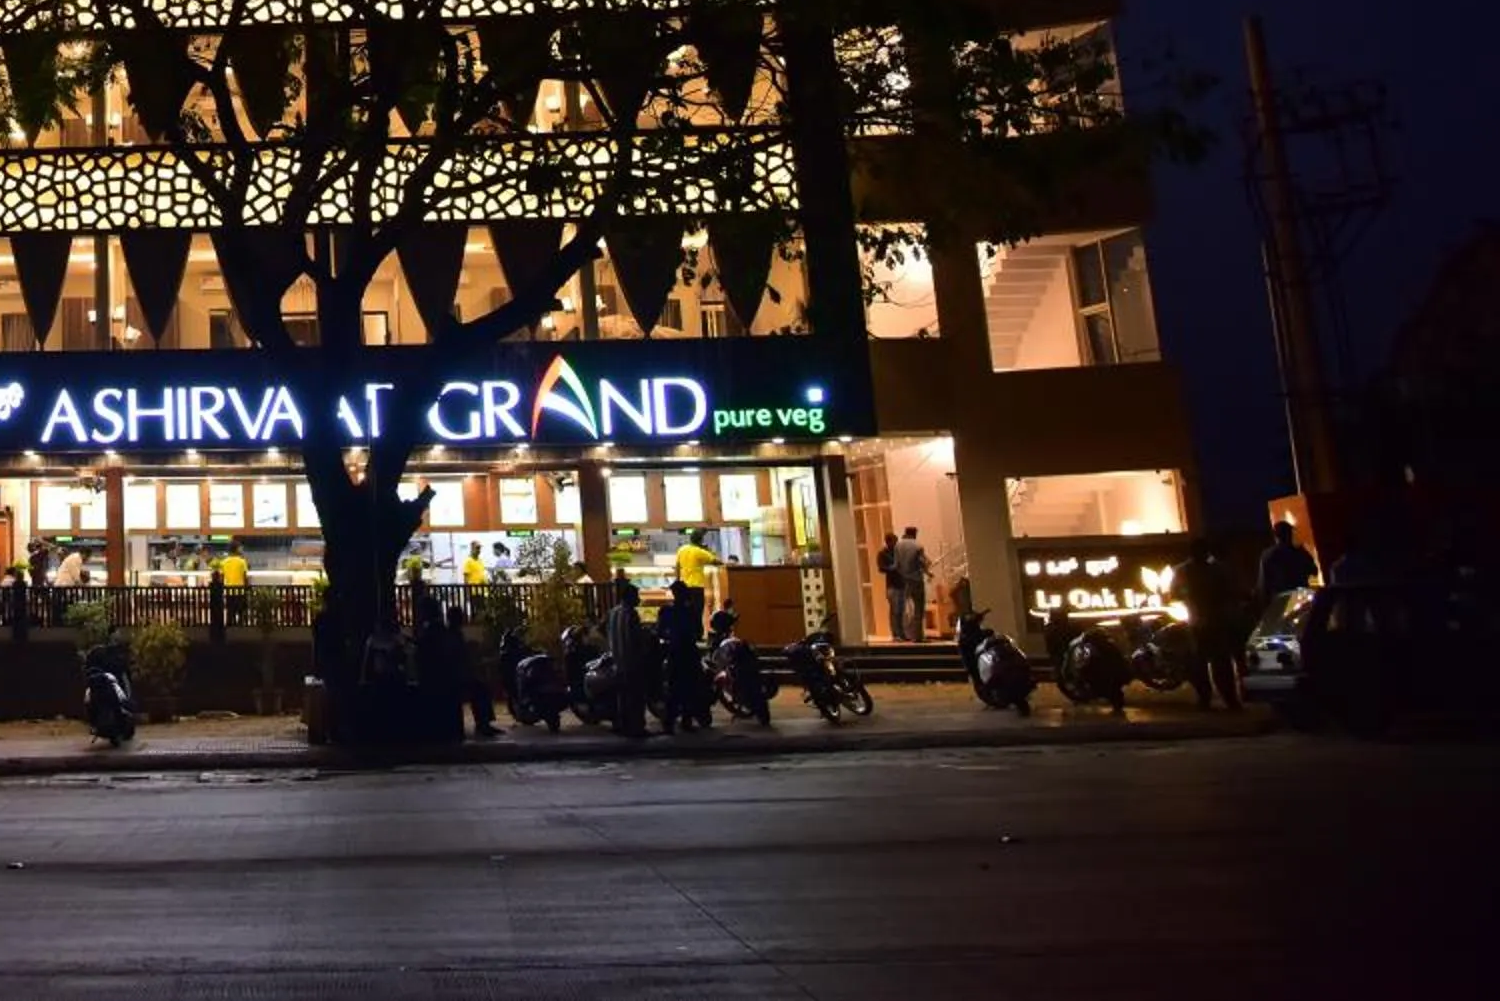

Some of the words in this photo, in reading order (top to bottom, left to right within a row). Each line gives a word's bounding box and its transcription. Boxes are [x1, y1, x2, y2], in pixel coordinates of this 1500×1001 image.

[427, 355, 707, 441] GRAND
[714, 407, 772, 433] pure
[776, 407, 824, 433] veg
